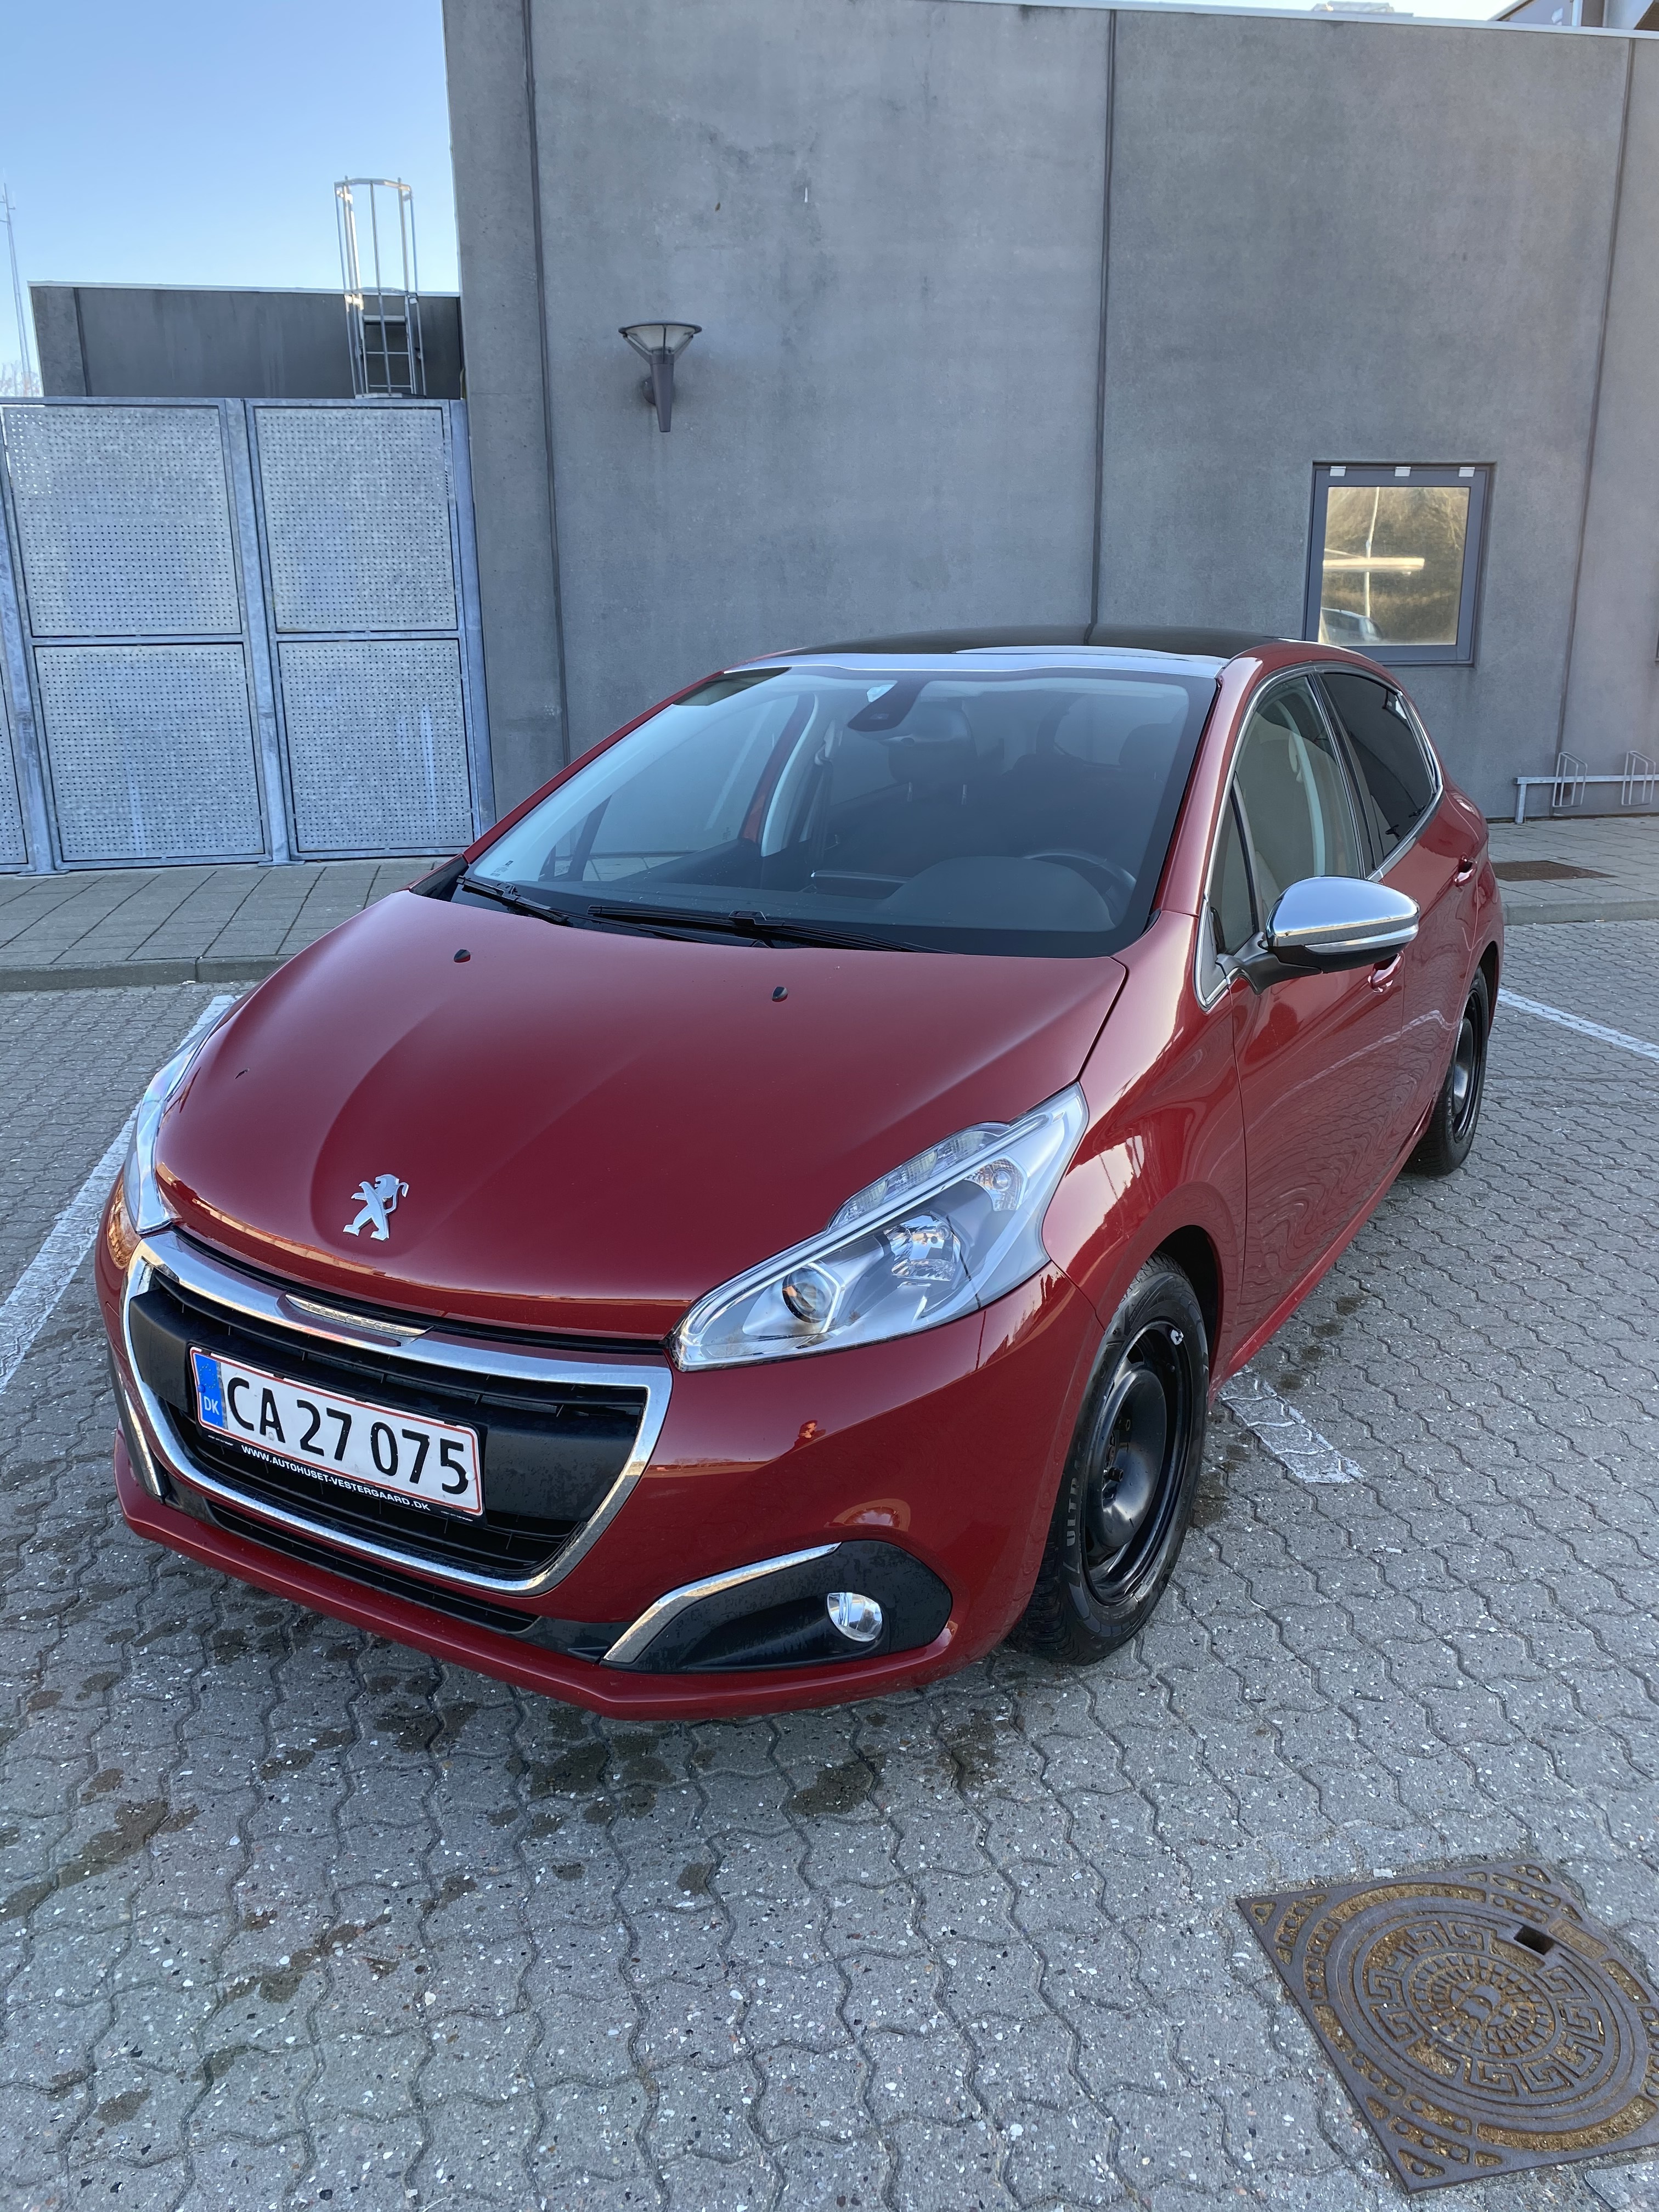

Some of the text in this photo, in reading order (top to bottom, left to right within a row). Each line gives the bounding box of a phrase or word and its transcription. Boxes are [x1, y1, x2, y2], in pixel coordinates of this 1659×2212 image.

[204, 1396, 219, 1415] DK
[227, 1377, 469, 1495] CA 27 075
[241, 1444, 431, 1511] WWW.AUTOHUSET-VESTERGAARD.DK
